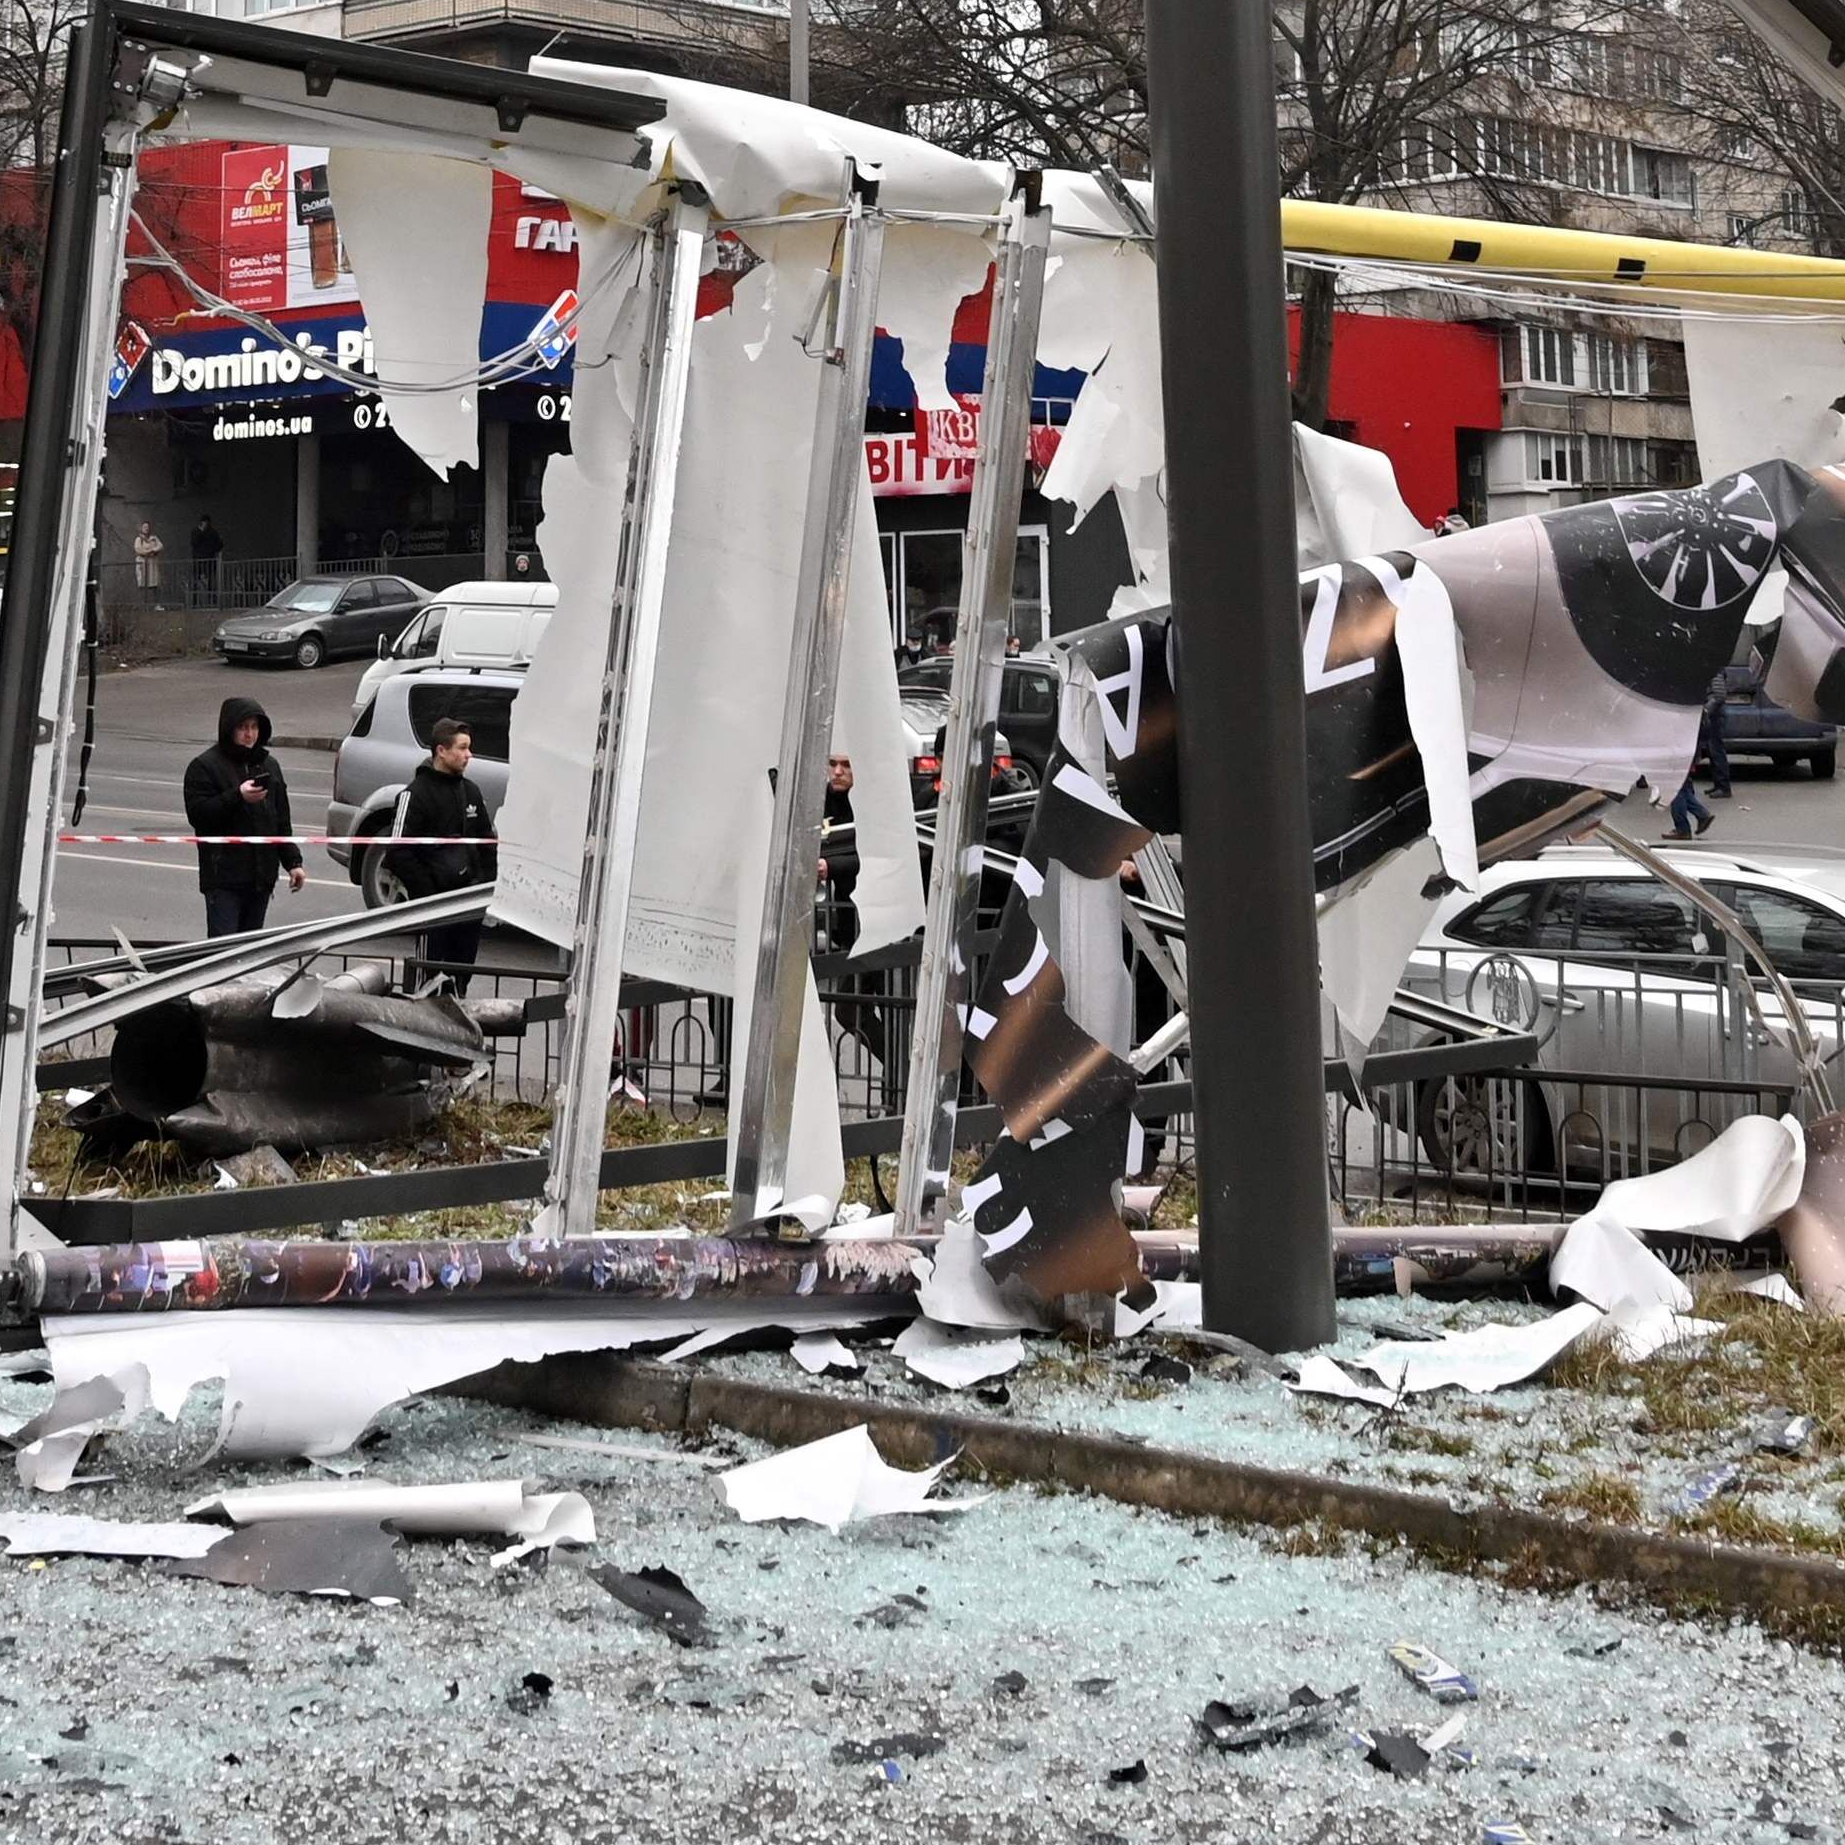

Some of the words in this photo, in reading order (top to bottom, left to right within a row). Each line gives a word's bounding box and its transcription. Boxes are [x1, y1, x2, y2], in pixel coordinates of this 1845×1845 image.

[231, 202, 283, 221] ВЕЛМАРТ
[152, 332, 329, 394] Domino's
[213, 414, 312, 441] dominos.ua
